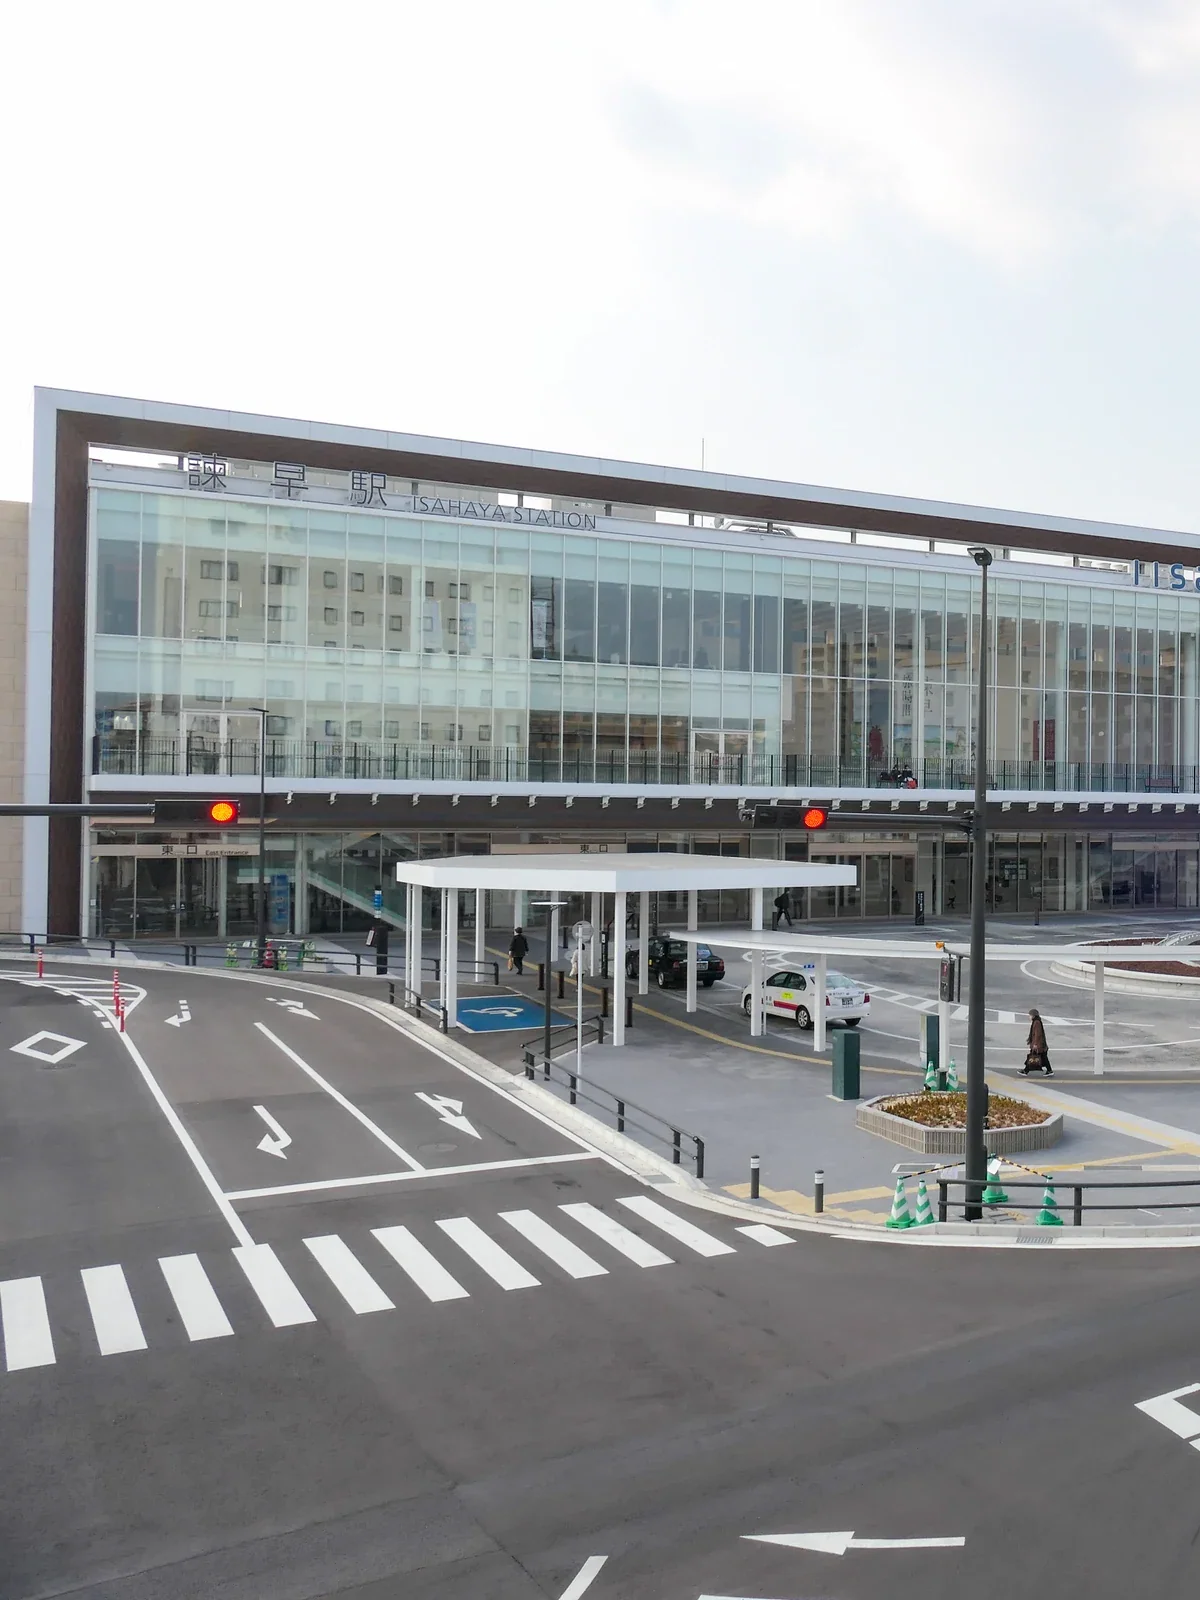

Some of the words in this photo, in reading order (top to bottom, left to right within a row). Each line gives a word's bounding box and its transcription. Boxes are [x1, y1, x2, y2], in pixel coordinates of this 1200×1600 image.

[187, 451, 388, 507] 諫早駅
[412, 495, 506, 520] ISAHAYA
[513, 505, 597, 530] STATION
